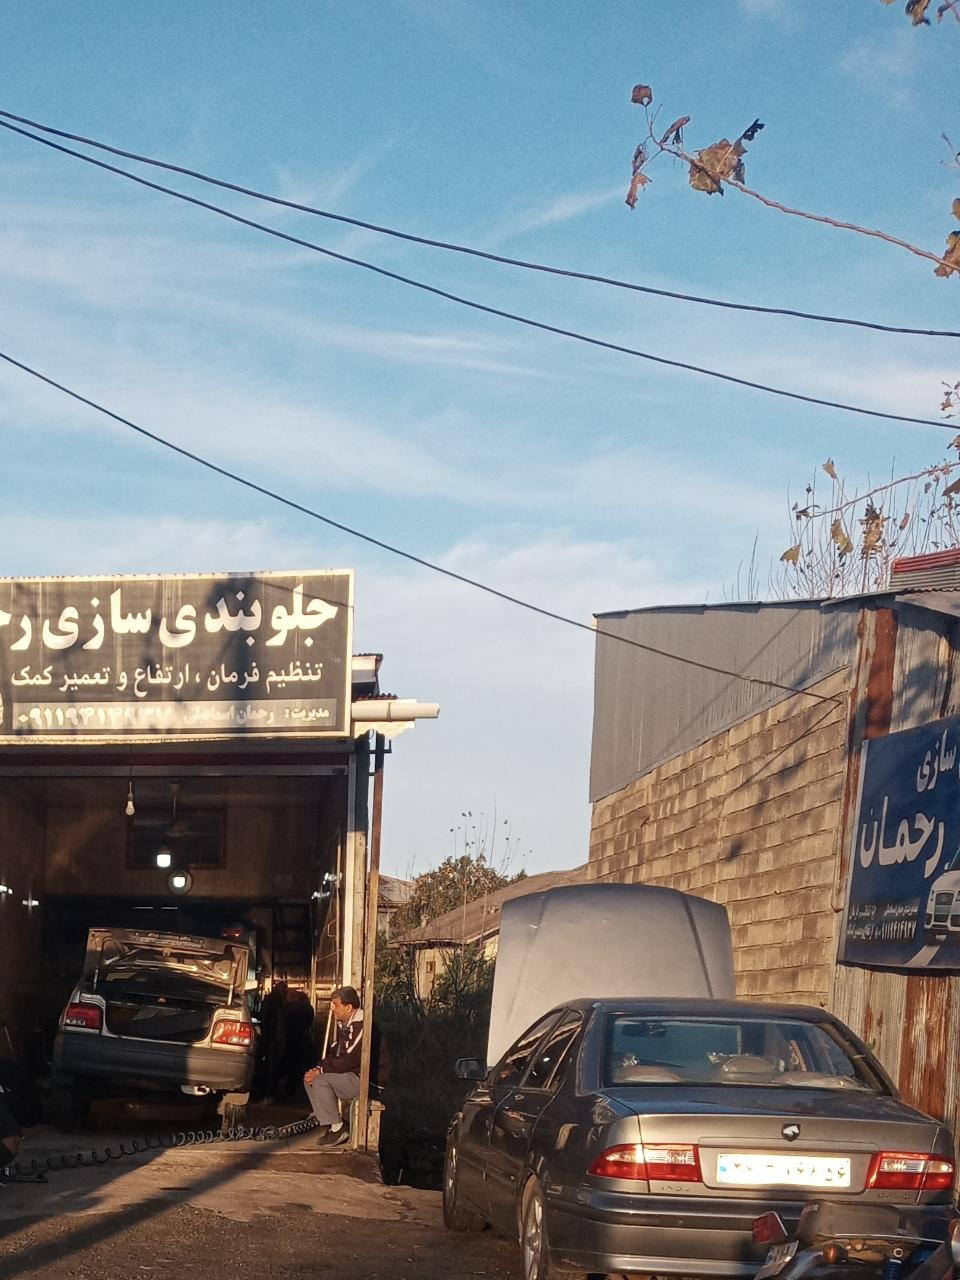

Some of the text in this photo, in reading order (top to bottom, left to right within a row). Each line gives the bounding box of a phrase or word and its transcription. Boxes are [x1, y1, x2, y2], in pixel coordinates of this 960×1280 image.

[42, 587, 153, 650] سازی
[11, 664, 54, 687] کمک
[58, 666, 111, 692] تعمیر
[116, 670, 128, 692] و
[133, 663, 190, 698] ارتفاع
[207, 661, 260, 692] فرمان
[265, 660, 324, 694] تنظیم
[916, 727, 957, 793] سازی
[859, 795, 945, 879] رحمان
